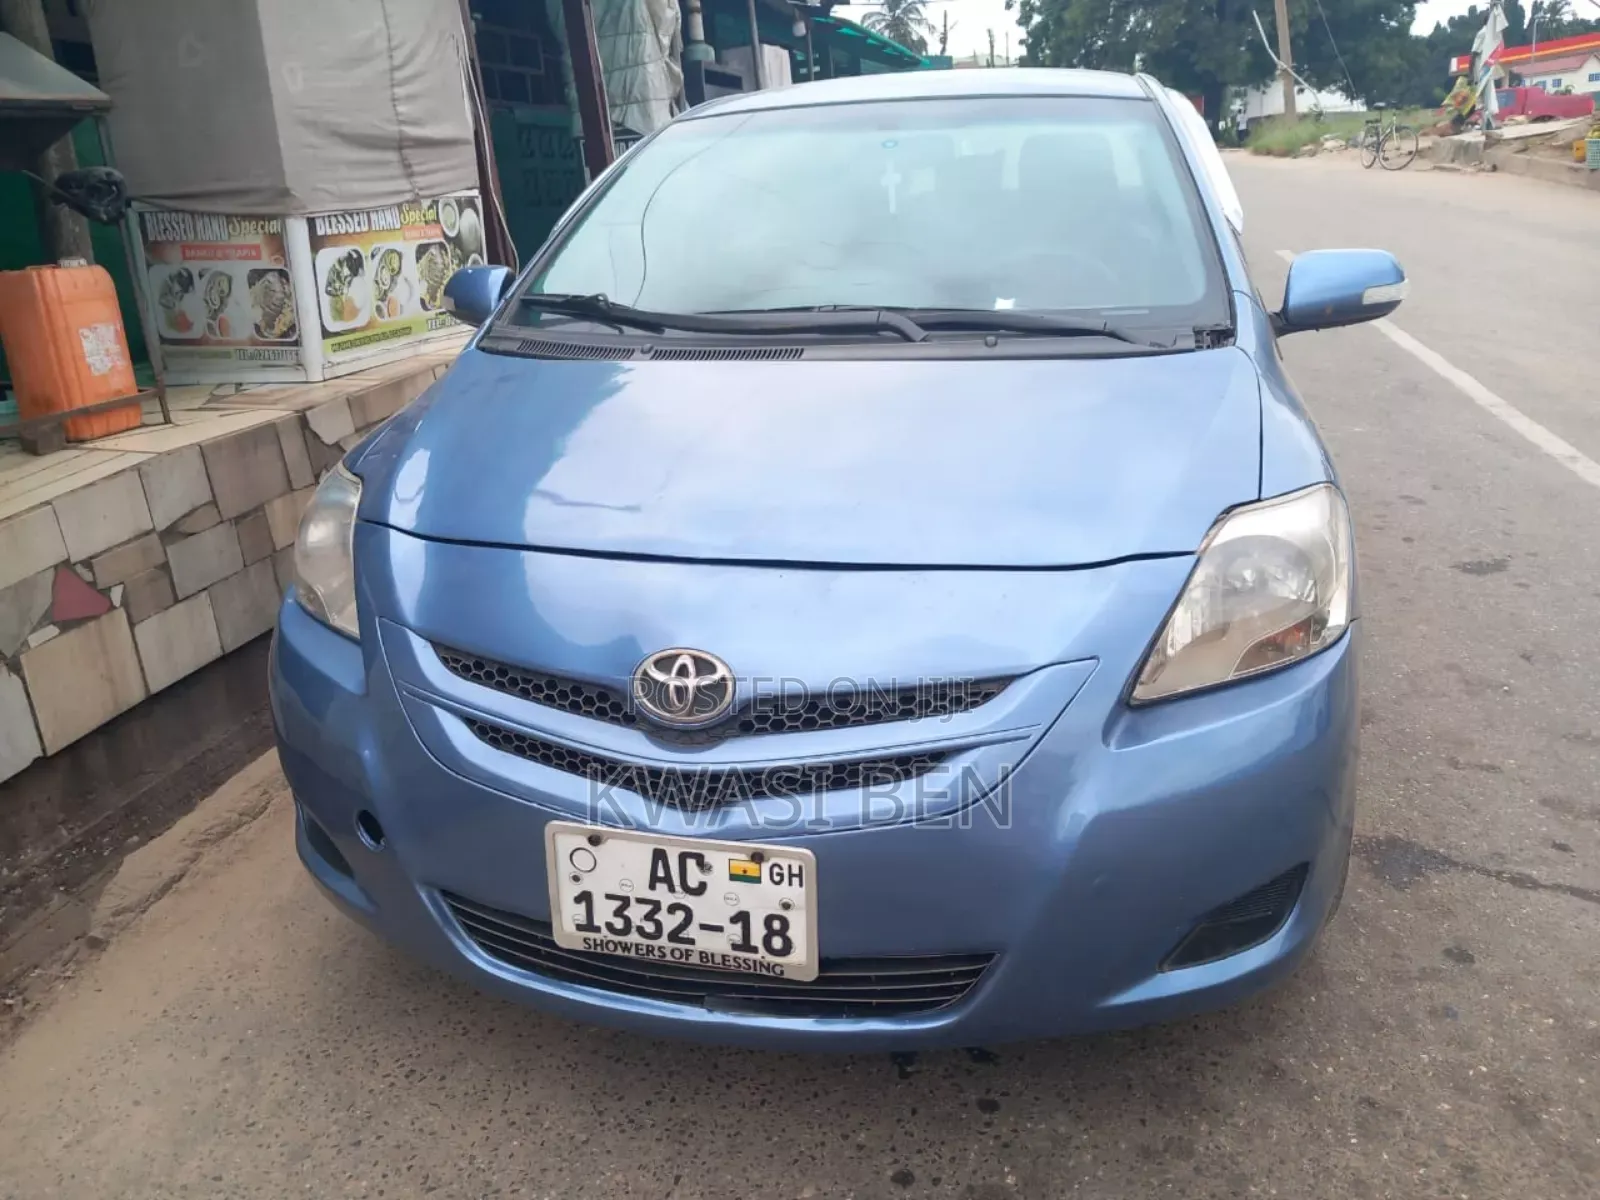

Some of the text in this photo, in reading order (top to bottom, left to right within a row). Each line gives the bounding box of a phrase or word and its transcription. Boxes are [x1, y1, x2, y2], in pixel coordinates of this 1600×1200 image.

[143, 212, 281, 241] BLESSED HAND Special
[315, 203, 438, 236] BLESSED HAND Special
[648, 847, 708, 897] AC
[769, 863, 804, 888] GH
[573, 889, 794, 958] 1332-18
[583, 937, 785, 977] SHOWERS OF BLESSING
